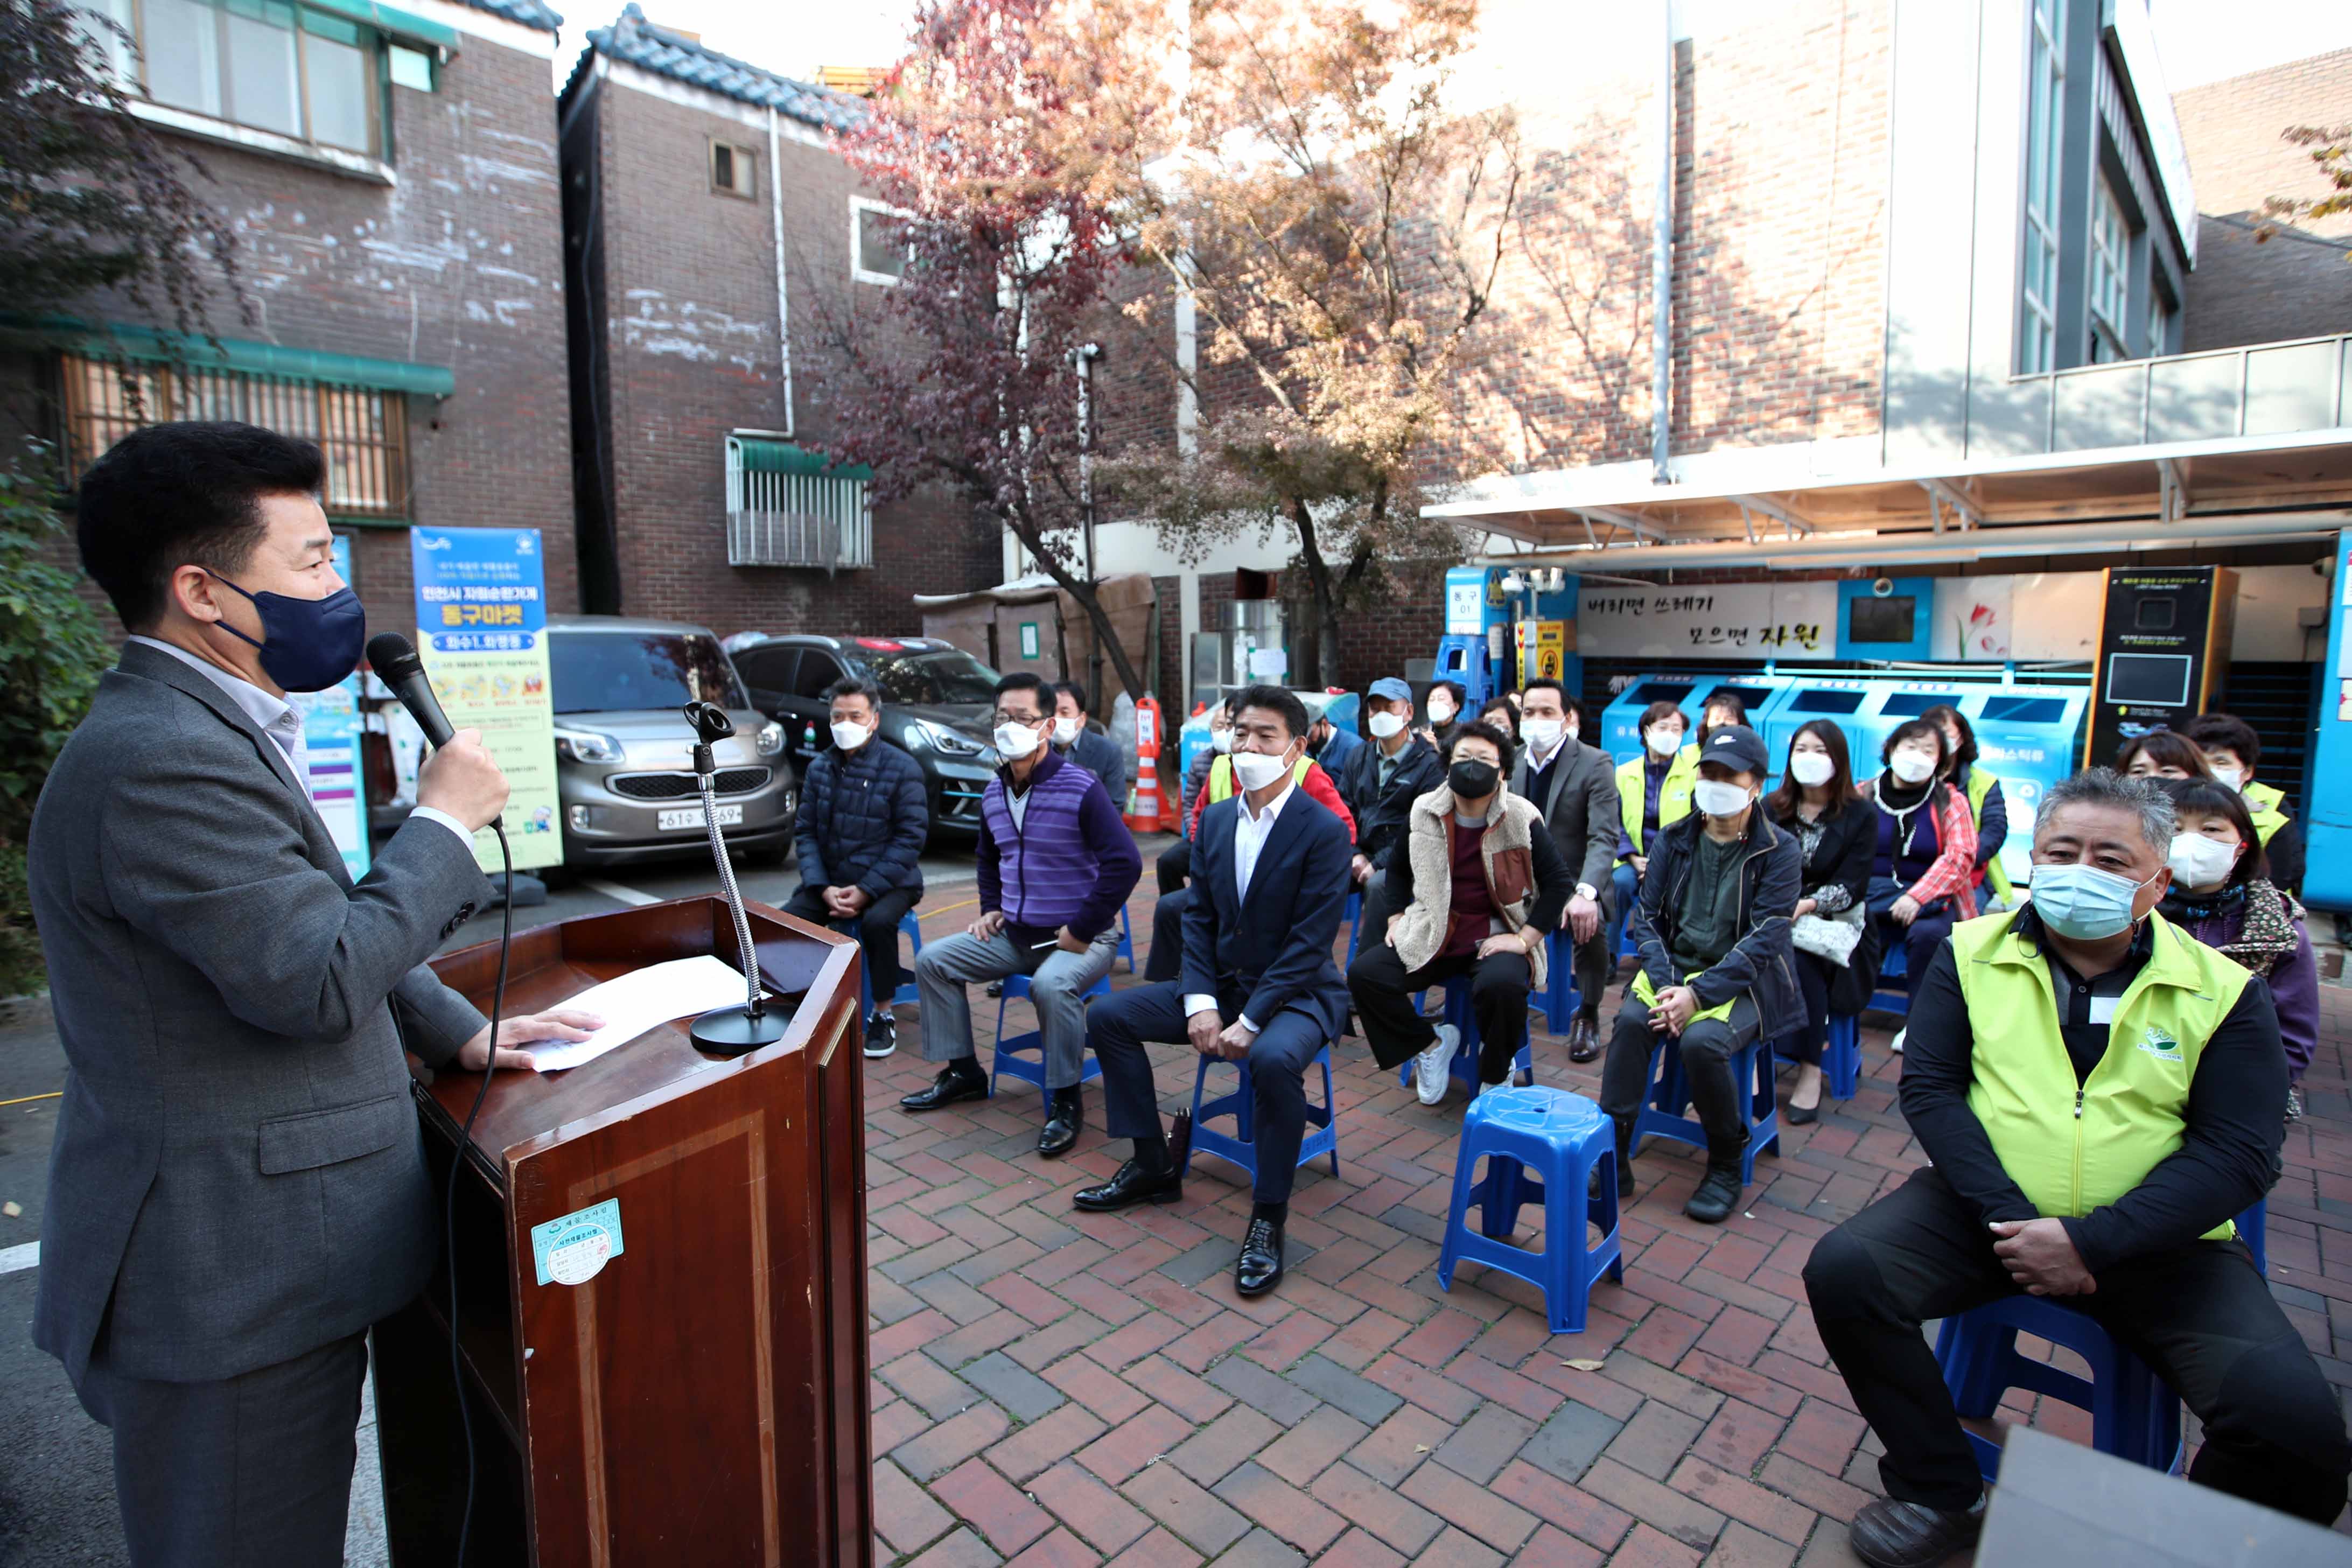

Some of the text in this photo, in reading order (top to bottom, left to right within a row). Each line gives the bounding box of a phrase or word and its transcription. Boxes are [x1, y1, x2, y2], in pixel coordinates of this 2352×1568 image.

[422, 585, 462, 602] 인천시
[1460, 605, 1470, 613] 01
[1655, 596, 1713, 613] 쓰레기
[442, 604, 524, 626] 동구마켓
[1690, 624, 1821, 650] 모으면 자원
